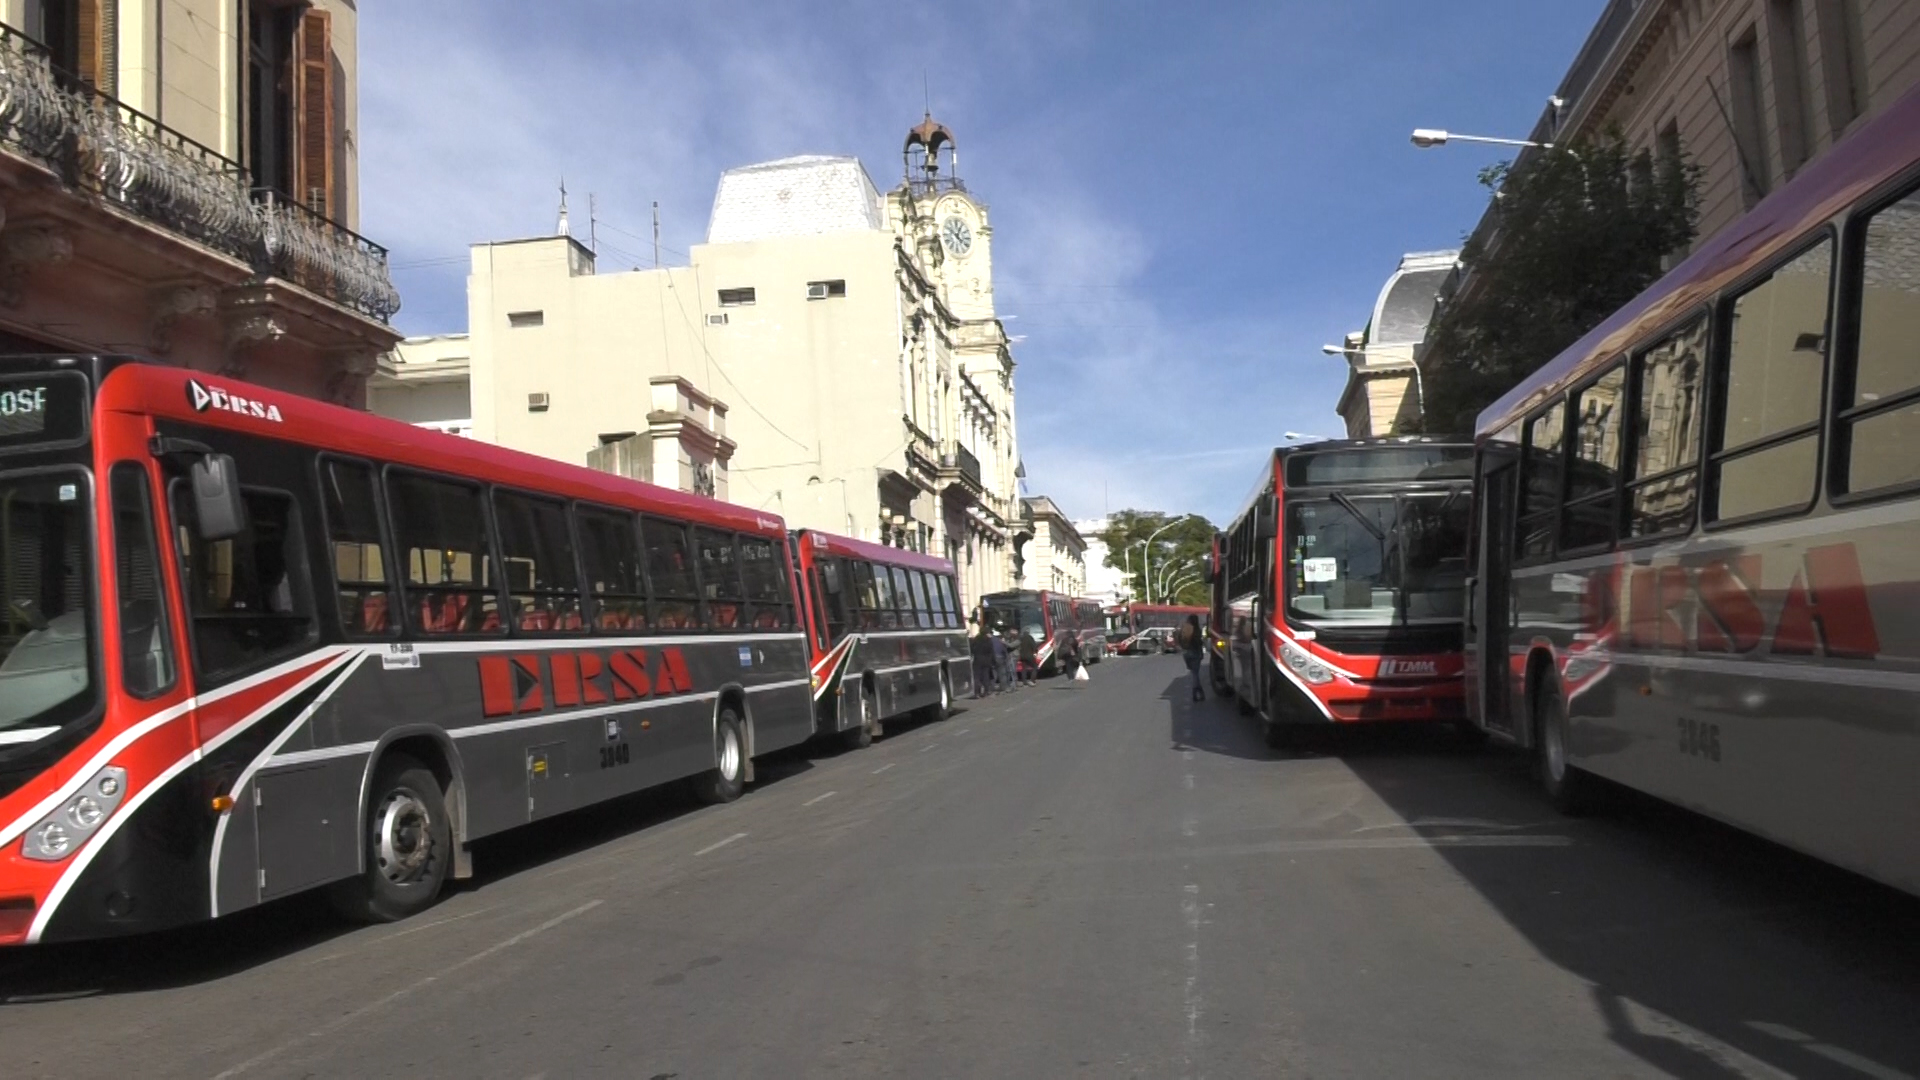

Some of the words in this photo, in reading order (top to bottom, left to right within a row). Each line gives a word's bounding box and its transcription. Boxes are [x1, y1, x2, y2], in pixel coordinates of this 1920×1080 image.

[0, 387, 47, 415] OSF
[210, 390, 283, 422] ERSA
[478, 648, 692, 717] ERSA
